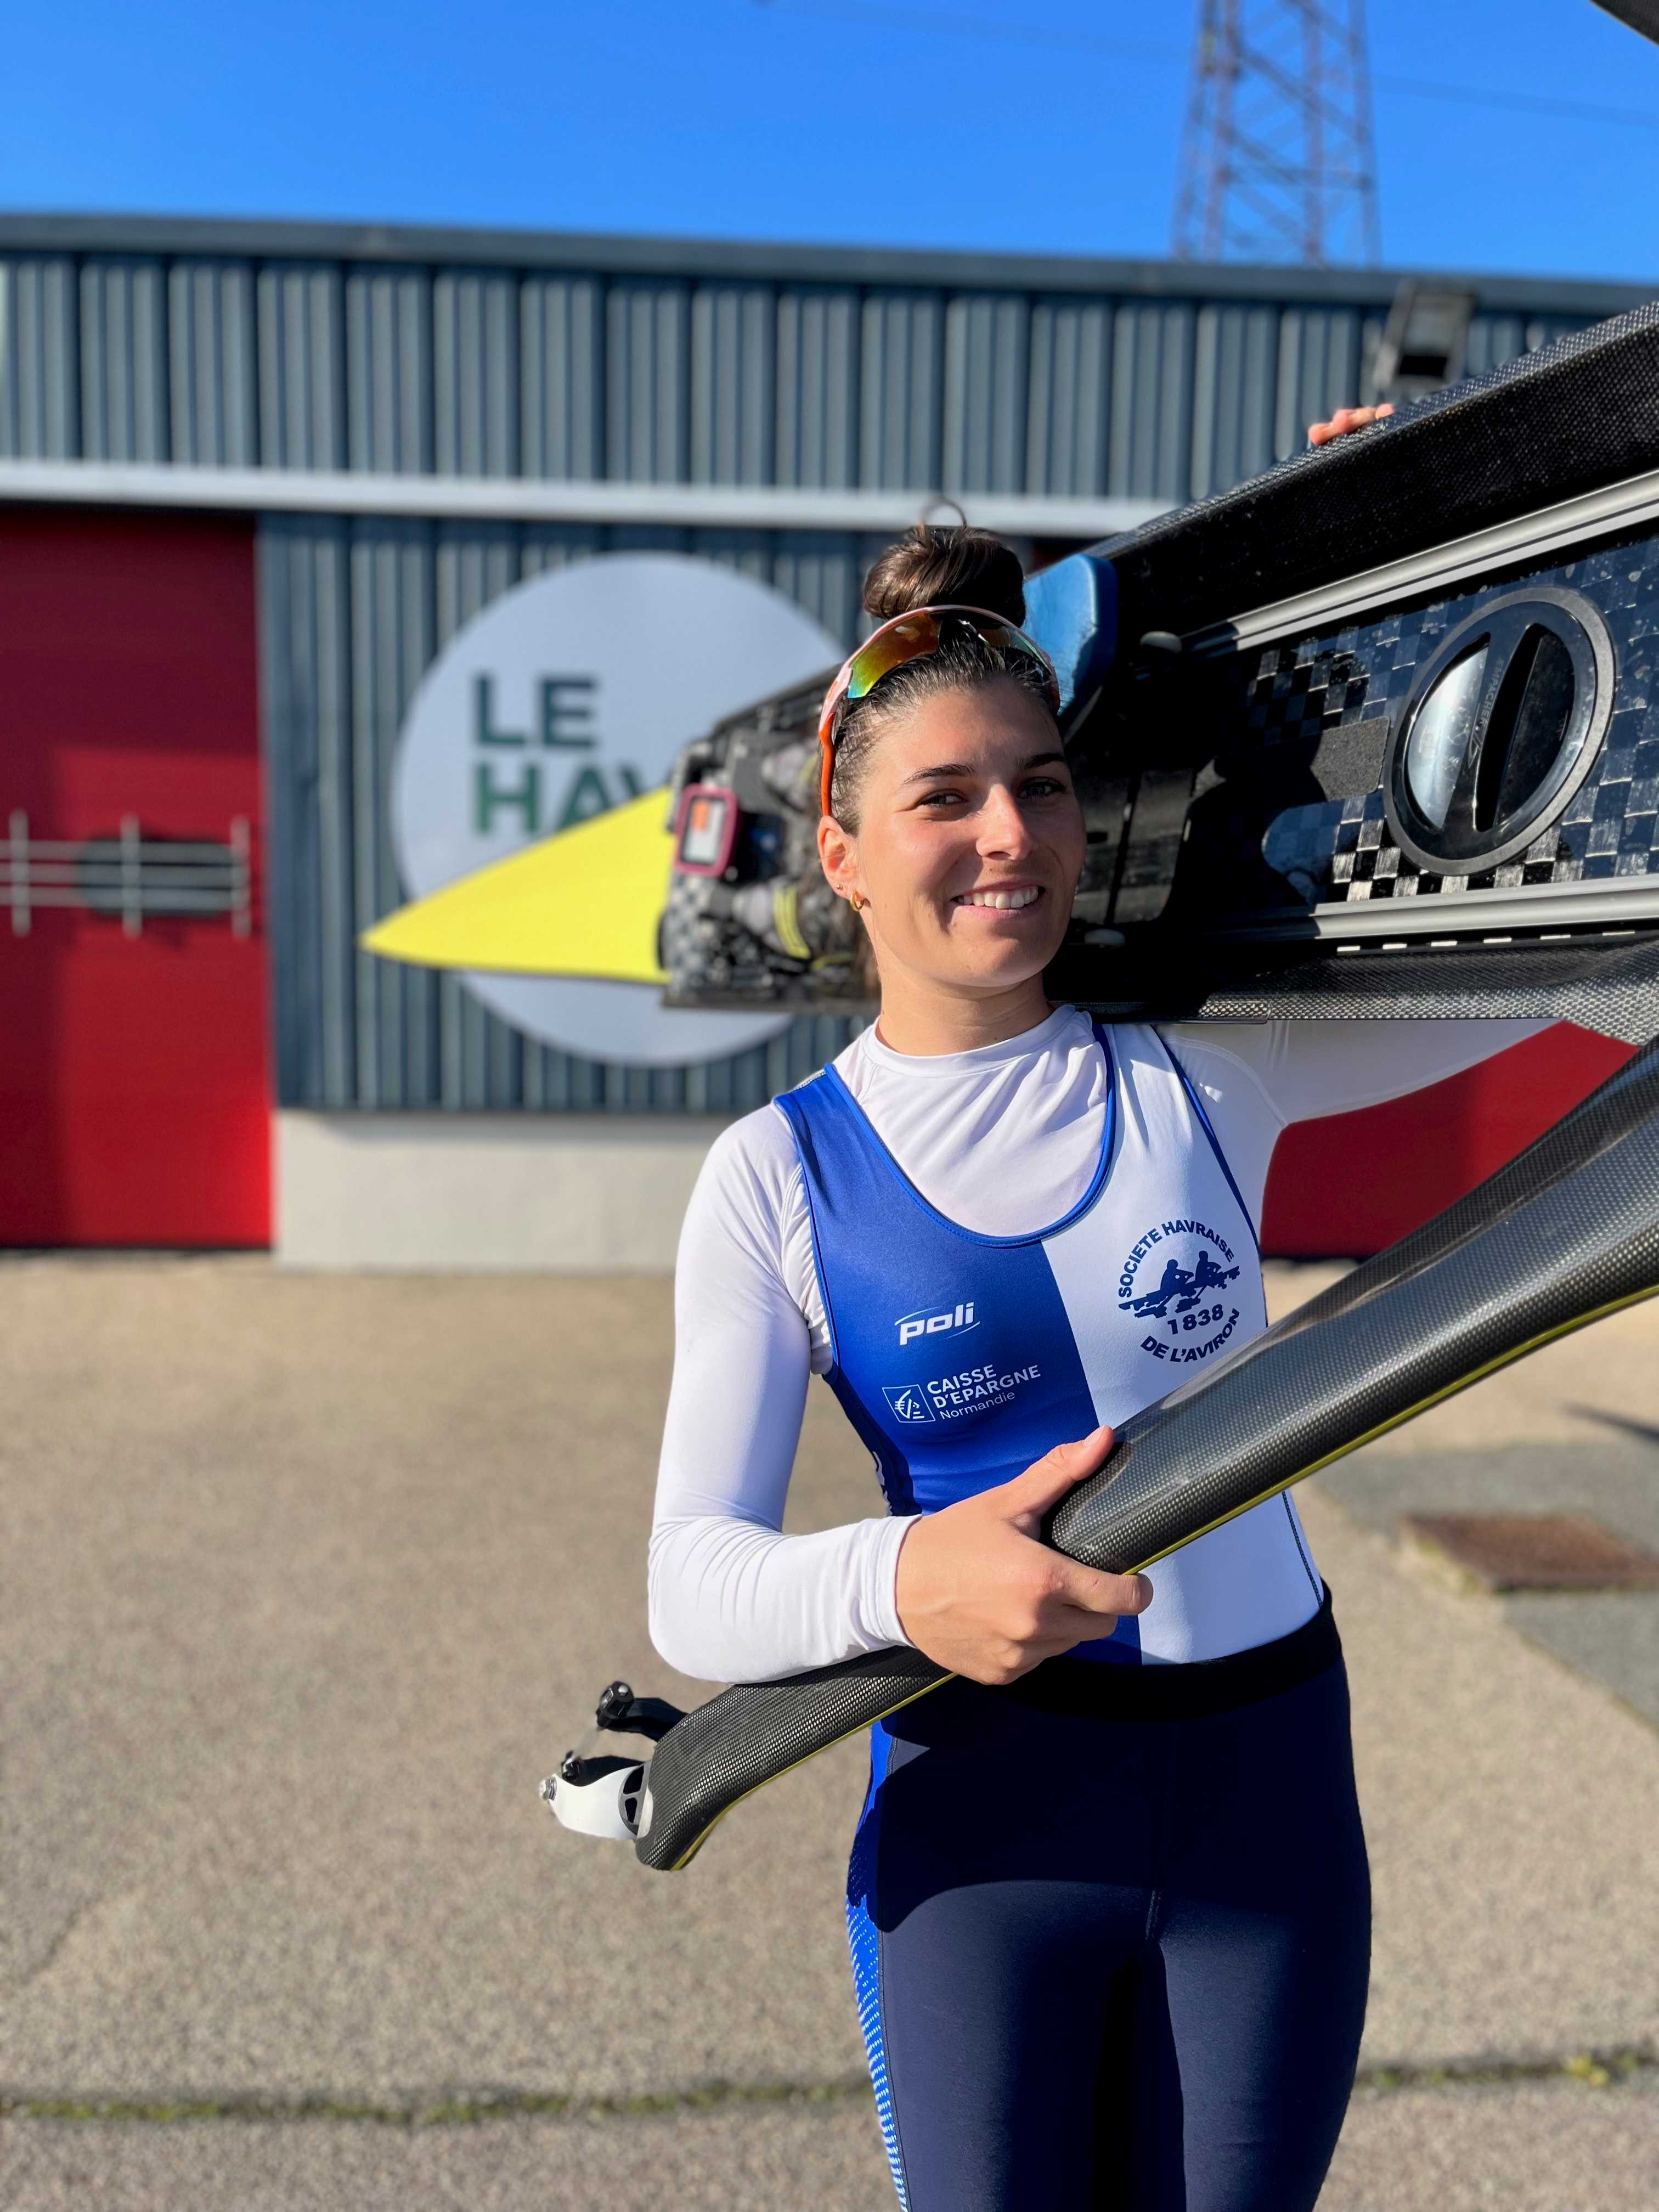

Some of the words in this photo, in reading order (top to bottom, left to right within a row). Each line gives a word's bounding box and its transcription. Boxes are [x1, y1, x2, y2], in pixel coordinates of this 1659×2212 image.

[475, 674, 596, 748] LE
[1480, 658, 1504, 727] EMPACHER
[475, 763, 642, 835] HA
[1118, 1228, 1163, 1298] SOCIETE
[1161, 1220, 1234, 1263] HAVRAISE
[899, 1301, 975, 1346] poli
[1141, 1335, 1170, 1359] DE
[1170, 1308, 1240, 1363] L'AVIRON
[1167, 1304, 1224, 1335] 1838
[927, 1364, 997, 1395] CAISSE
[932, 1364, 1041, 1409] D'EPARGNE
[939, 1390, 1016, 1420] Normandie
